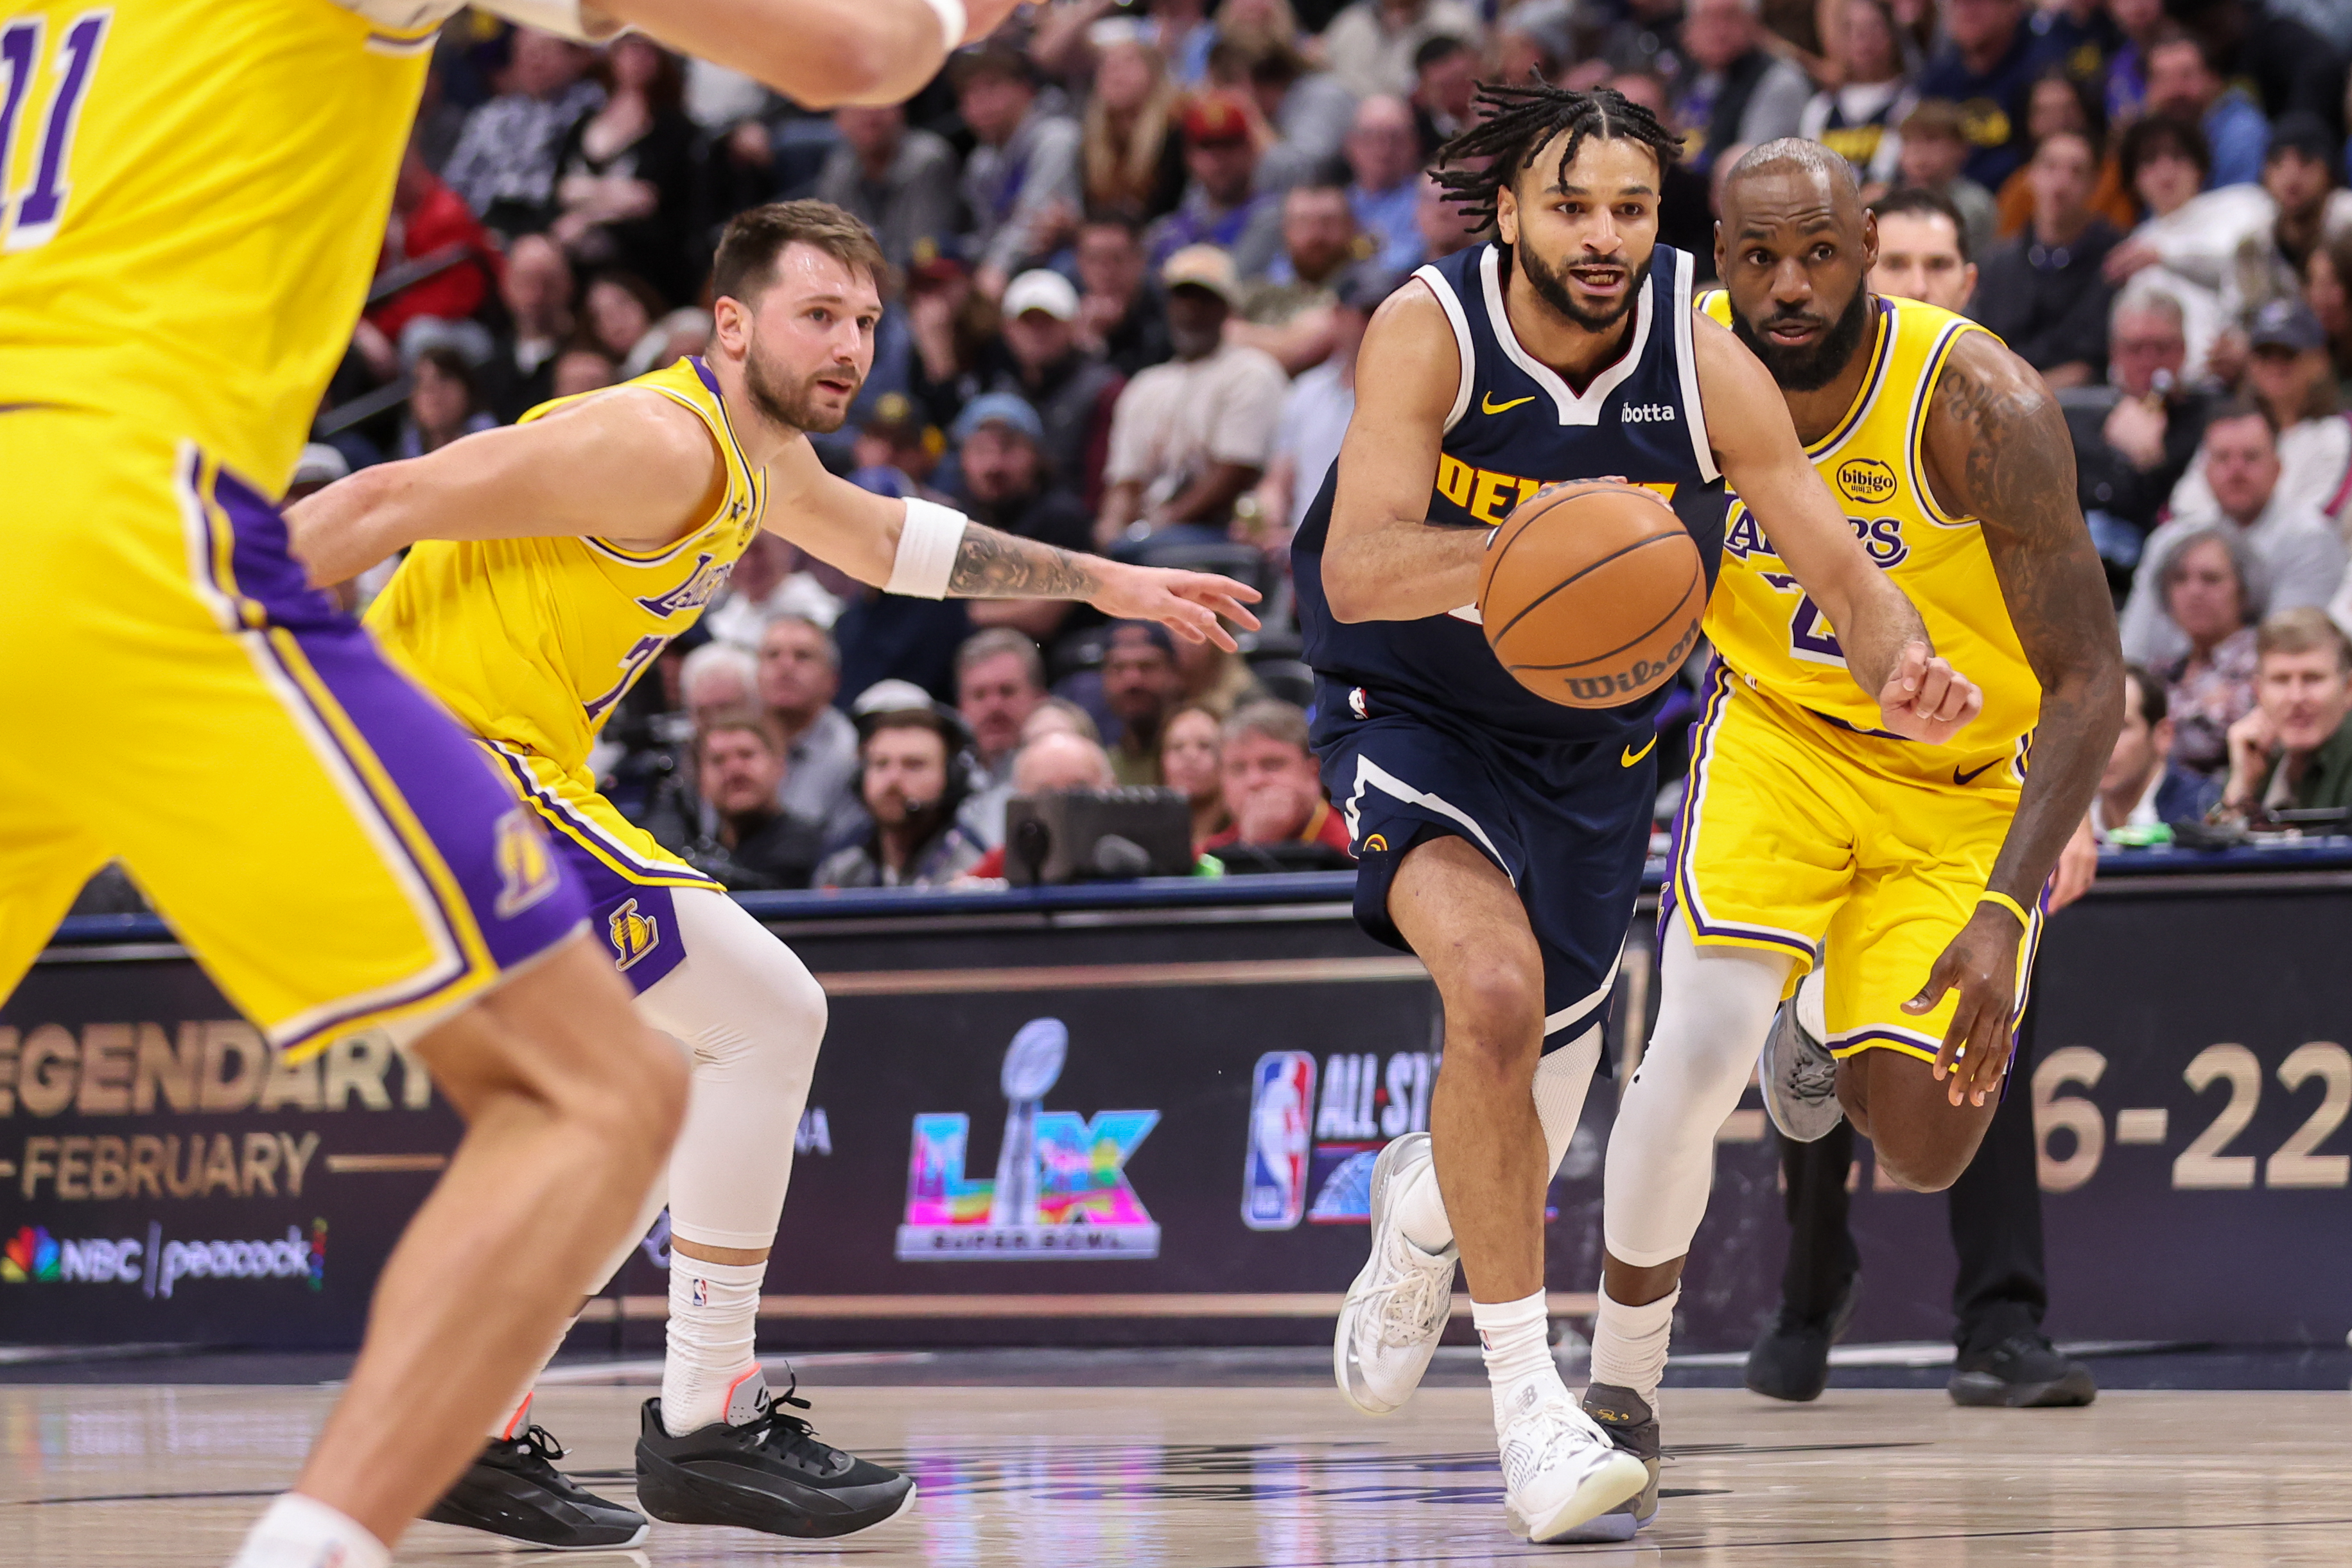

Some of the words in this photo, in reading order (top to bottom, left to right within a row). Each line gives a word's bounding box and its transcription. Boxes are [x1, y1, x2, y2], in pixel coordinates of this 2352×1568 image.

[1621, 401, 1675, 422] ibotta
[1842, 468, 1894, 492] bibigo
[1564, 618, 1700, 699] Wilson
[2030, 1041, 2352, 1194] 6-22
[22, 1132, 320, 1200] FEBRUARY
[63, 1238, 144, 1282] NBC
[160, 1225, 311, 1298] peacock
